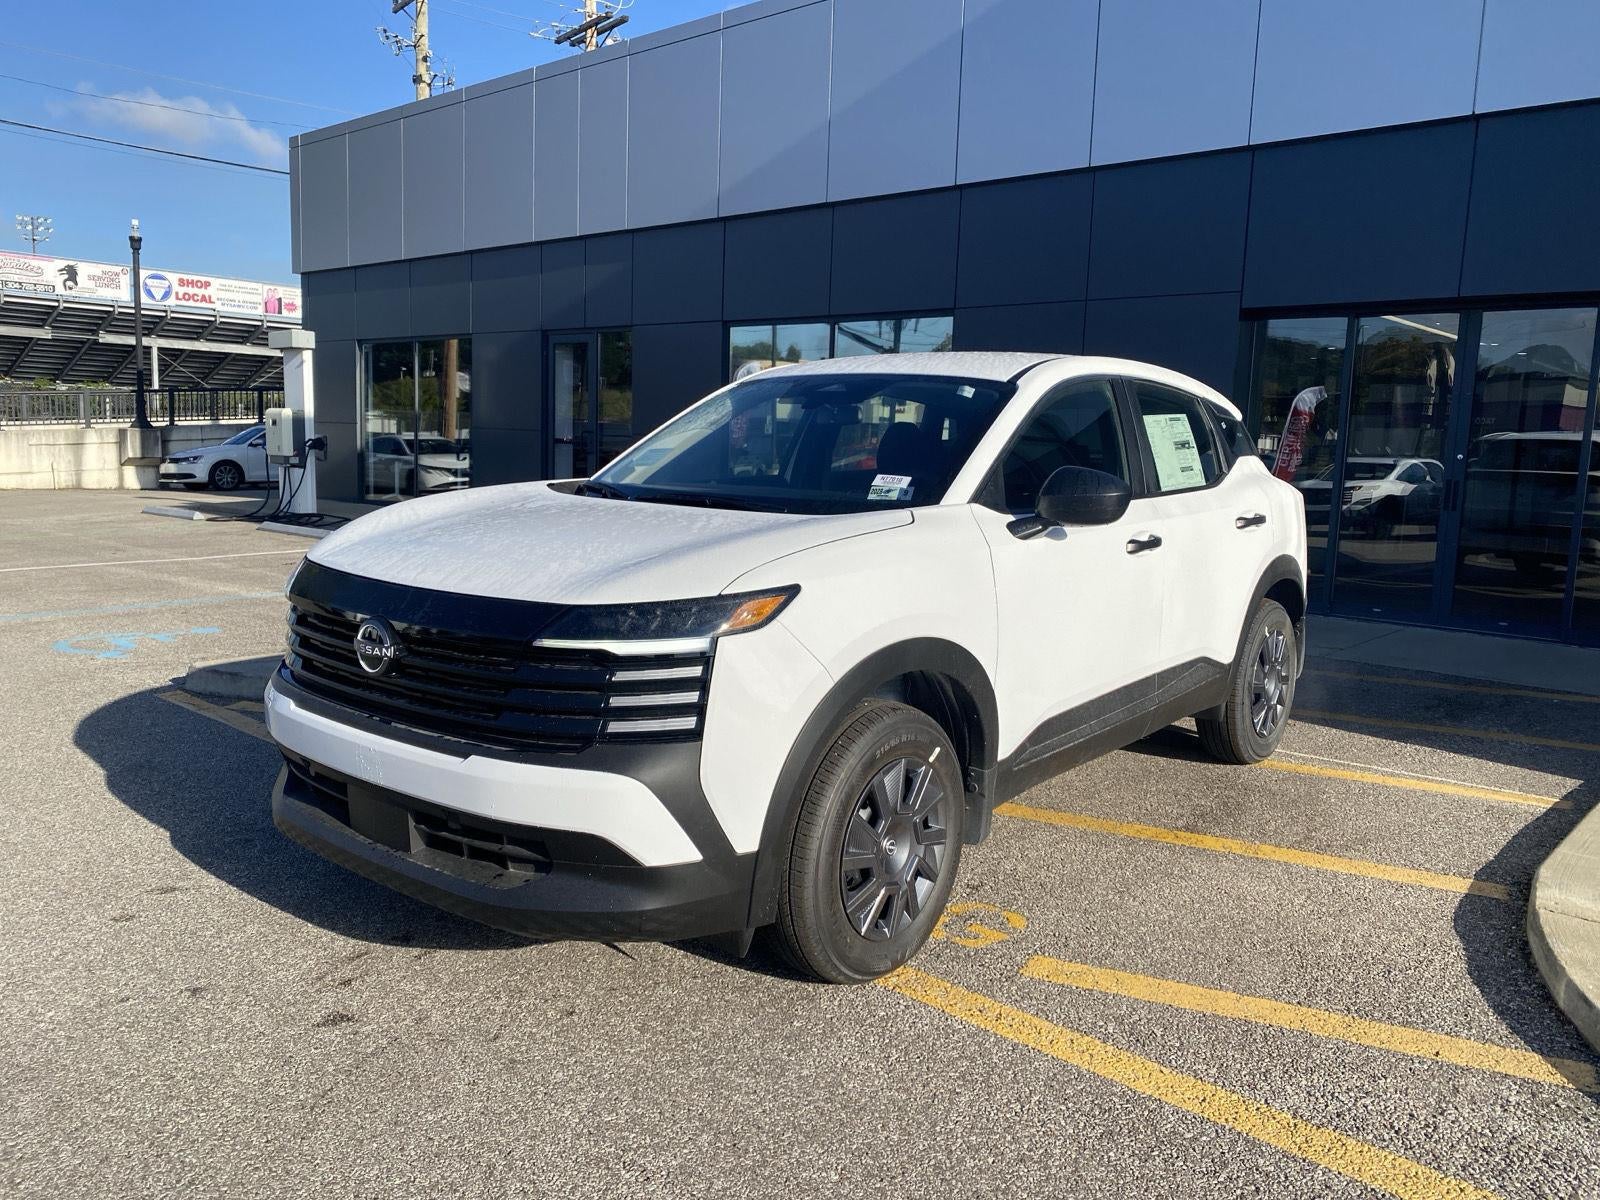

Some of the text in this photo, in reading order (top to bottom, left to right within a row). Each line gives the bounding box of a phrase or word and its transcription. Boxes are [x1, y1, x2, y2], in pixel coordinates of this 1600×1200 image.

[101, 270, 121, 278] NOW
[87, 275, 121, 284] SERVING
[177, 277, 212, 290] SHOP
[95, 281, 121, 290] LUNCH
[175, 291, 216, 304] LOCAL
